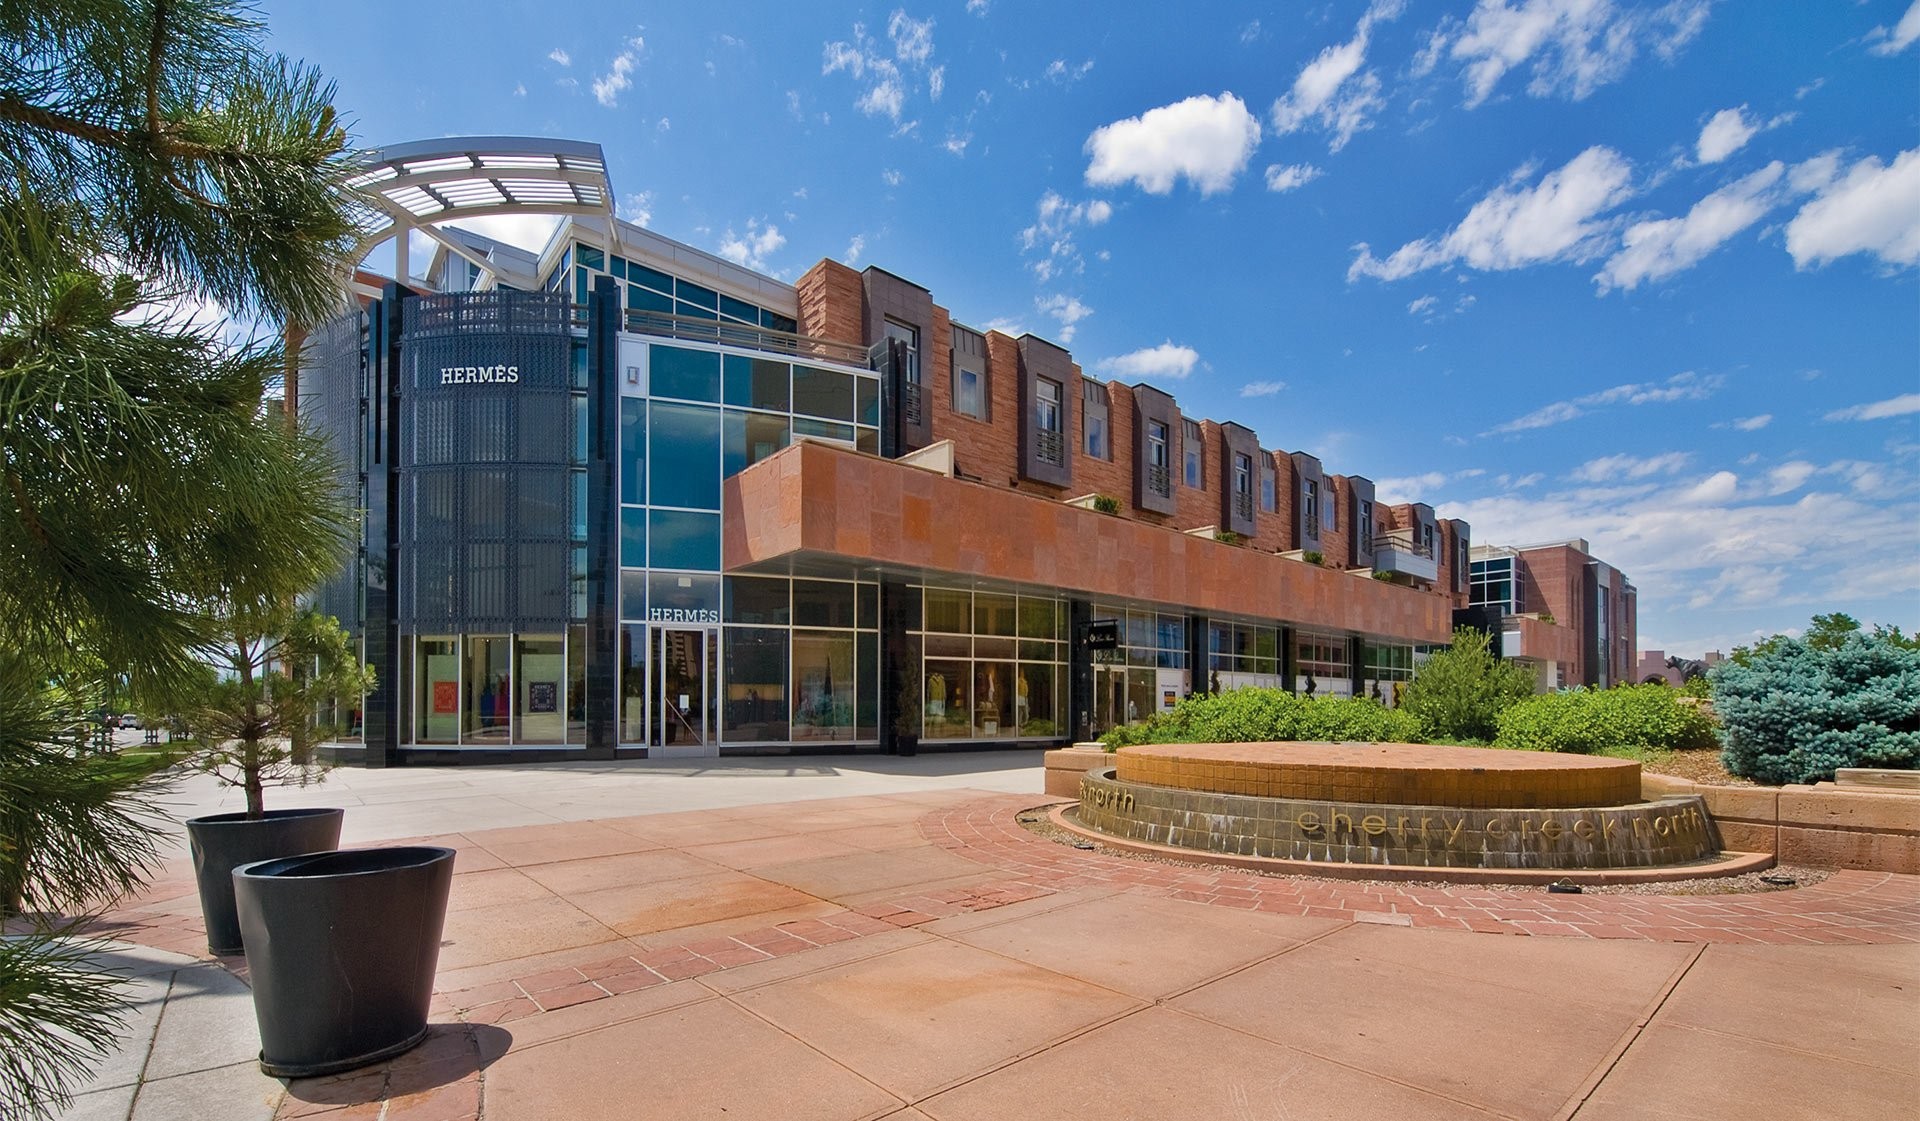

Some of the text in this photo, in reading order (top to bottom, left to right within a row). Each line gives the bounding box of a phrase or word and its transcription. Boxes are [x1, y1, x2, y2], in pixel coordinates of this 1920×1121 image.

[1297, 806, 1700, 845] cherry creek north
